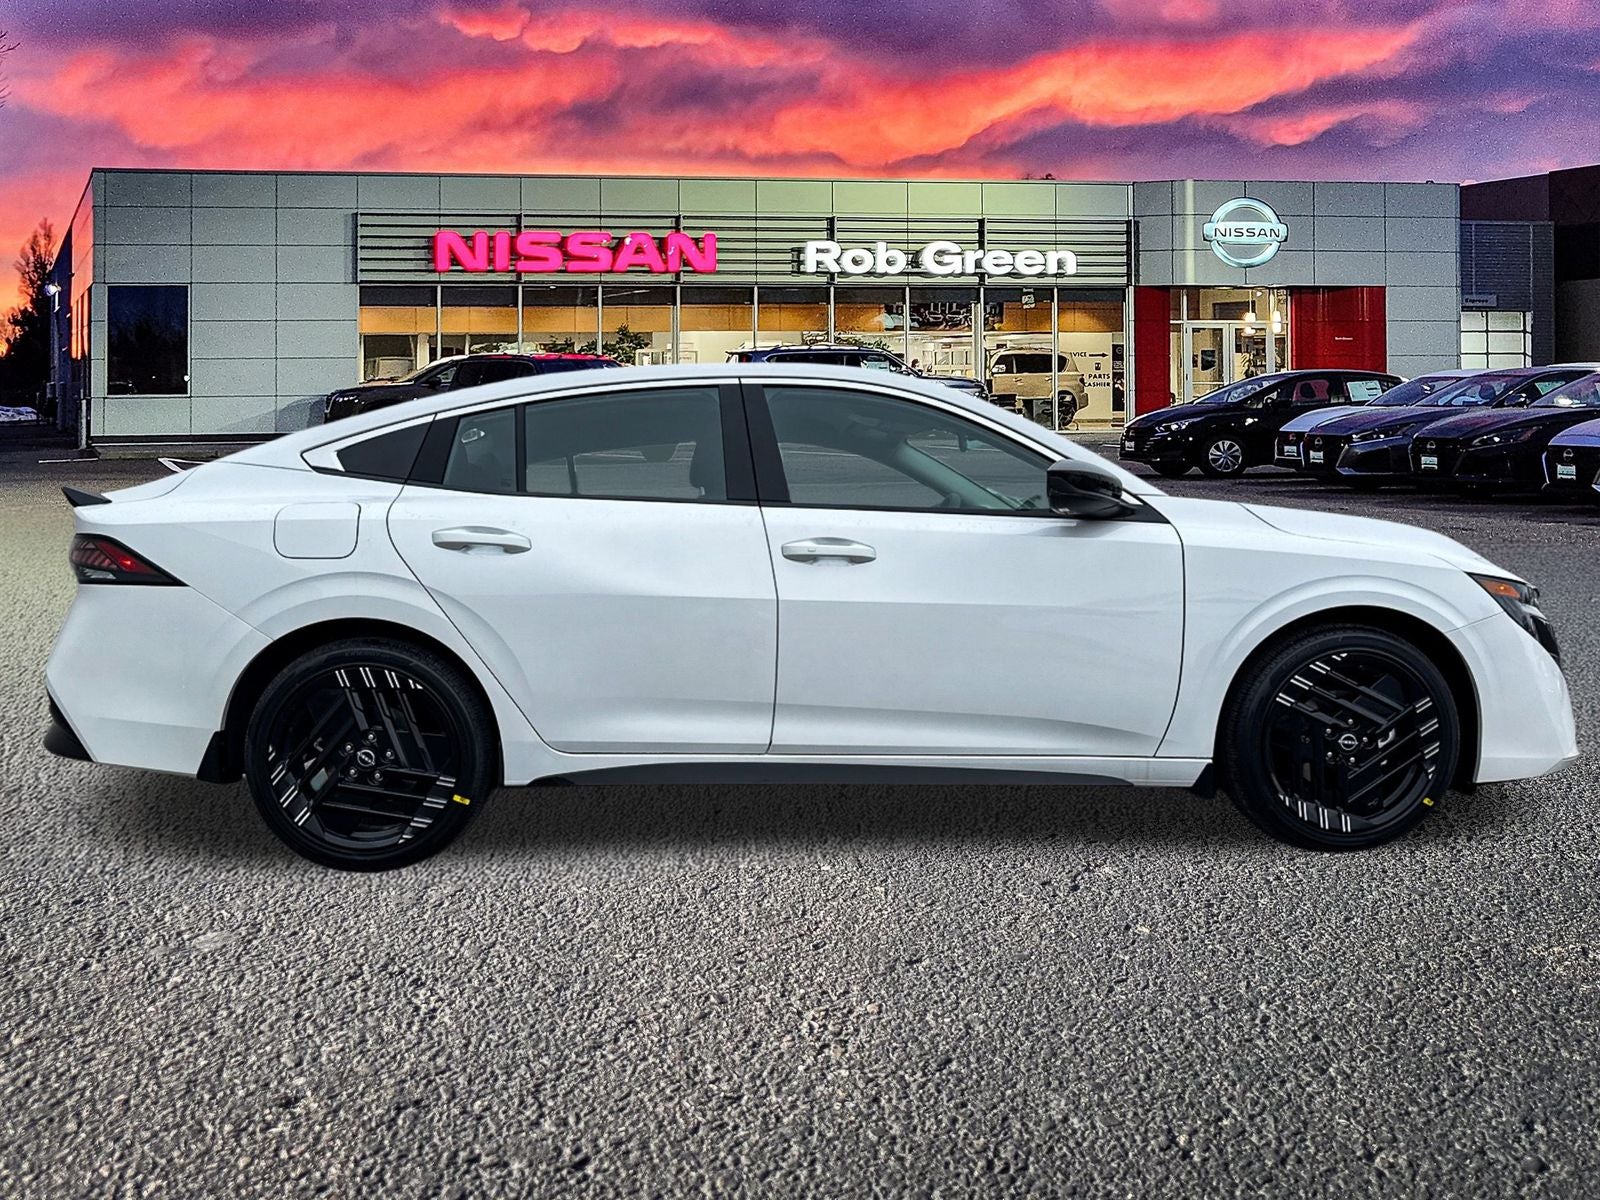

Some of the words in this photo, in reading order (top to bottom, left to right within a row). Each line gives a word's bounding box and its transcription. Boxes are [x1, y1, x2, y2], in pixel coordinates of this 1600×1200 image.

[1214, 227, 1280, 238] NISSAN
[434, 230, 718, 273] NISSAN
[804, 239, 907, 274] Rob
[921, 239, 1078, 276] Green
